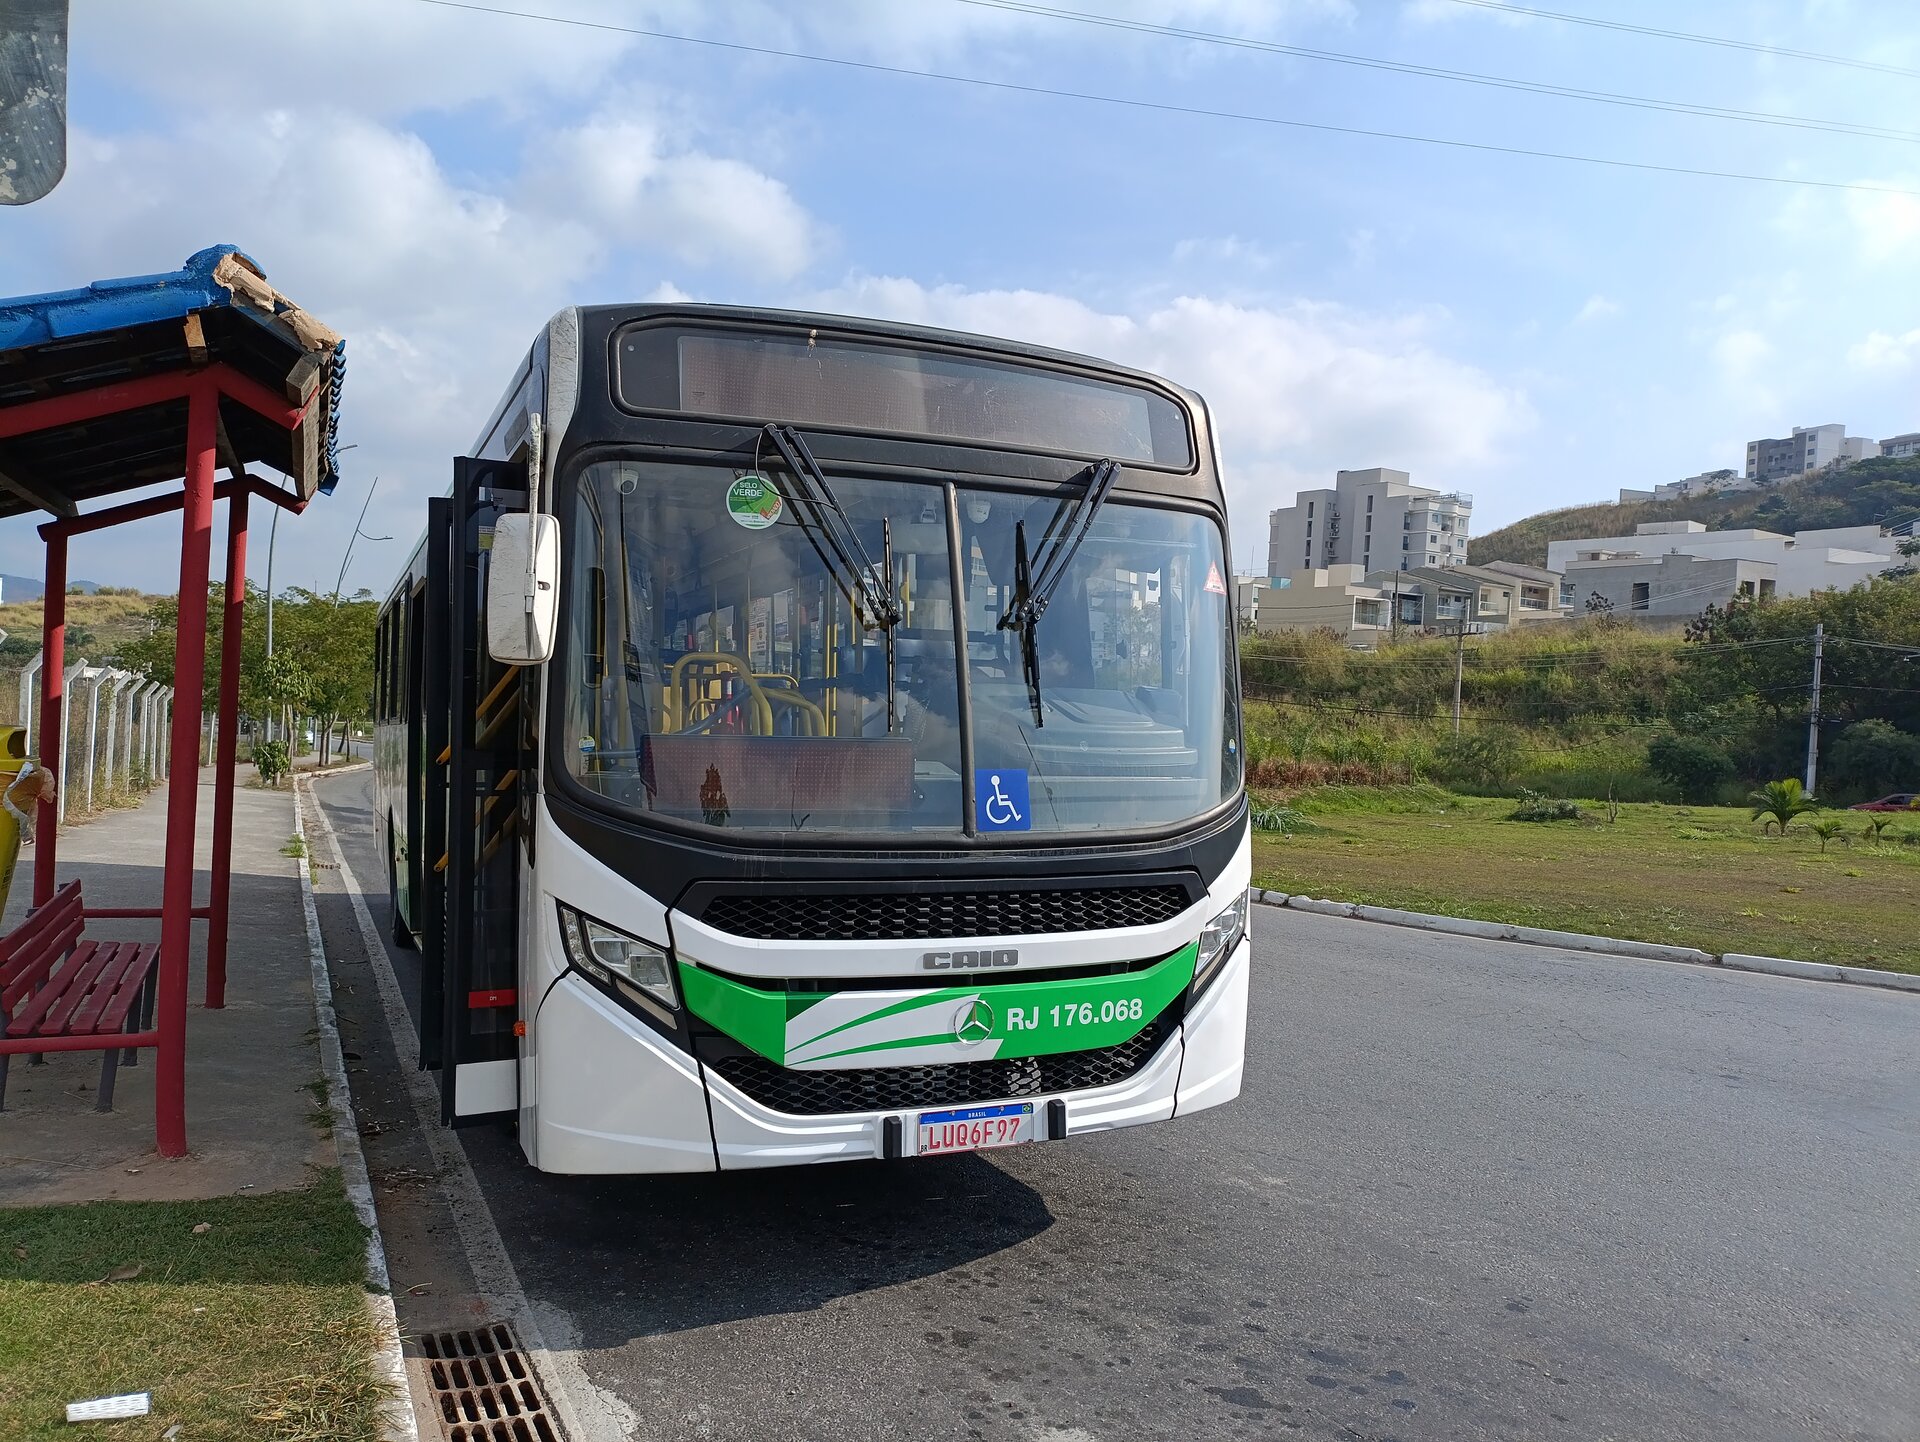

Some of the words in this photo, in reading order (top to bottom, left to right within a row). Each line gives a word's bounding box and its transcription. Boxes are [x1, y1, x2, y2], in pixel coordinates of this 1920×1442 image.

[733, 488, 763, 497] VERDE
[923, 950, 1019, 970] CAIO
[1006, 1006, 1040, 1031] RJ
[1049, 998, 1143, 1028] 176.068
[929, 1118, 1020, 1149] LUQ6F97
[920, 1144, 928, 1152] BR
